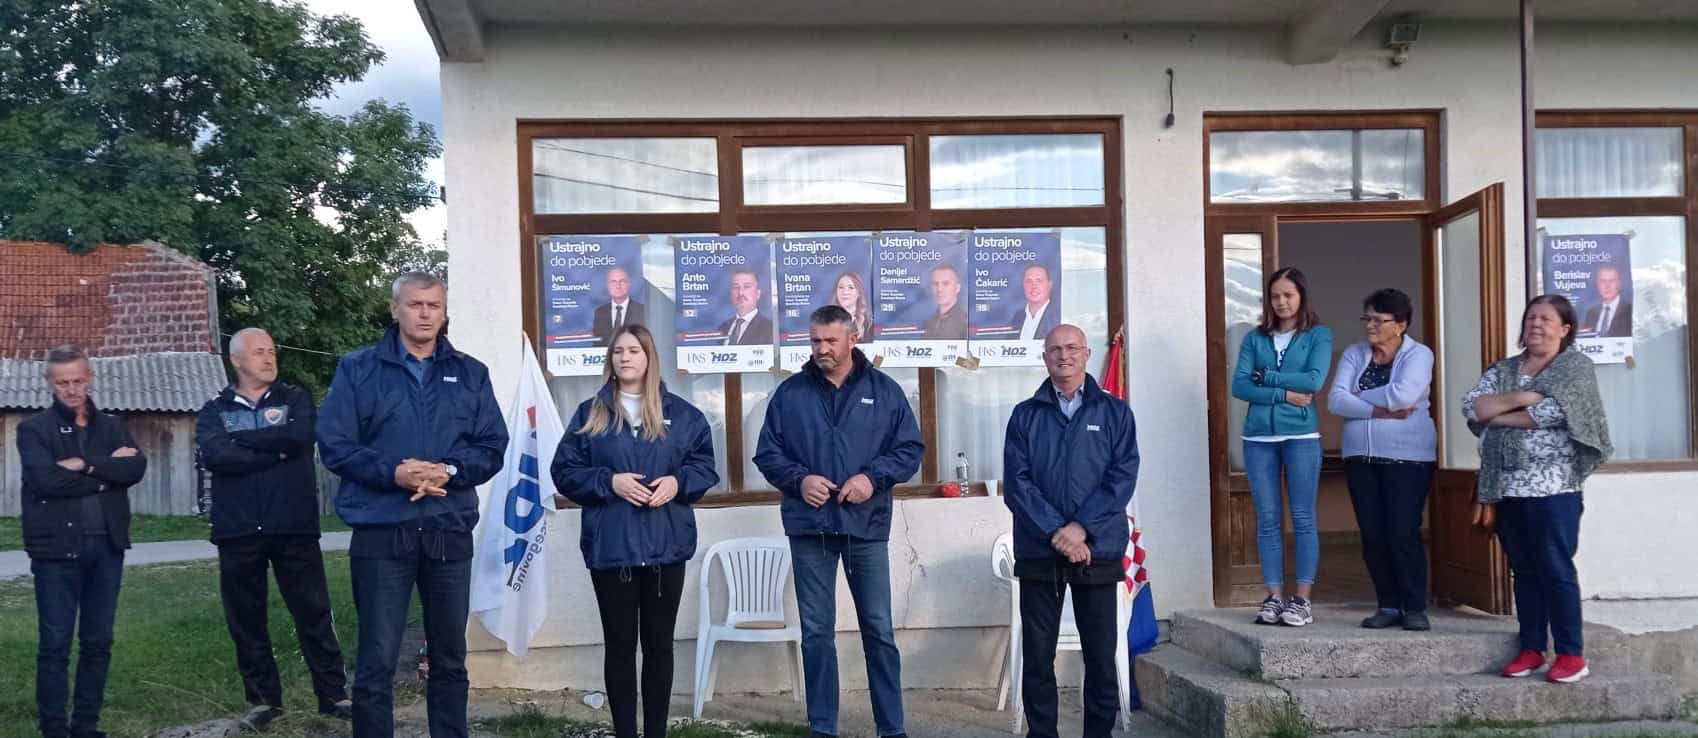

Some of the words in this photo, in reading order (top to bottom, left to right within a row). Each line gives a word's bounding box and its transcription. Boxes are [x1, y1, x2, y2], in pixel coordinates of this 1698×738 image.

[550, 241, 600, 255] Ustrajno
[681, 240, 730, 254] Ustrajno
[783, 240, 831, 254] Ustrajno
[880, 236, 927, 249] Ustrajno
[975, 236, 1022, 249] Ustrajno
[1551, 239, 1597, 251] Ustrajno
[551, 256, 566, 266] do
[568, 255, 616, 268] pobjede
[681, 255, 696, 265] do
[699, 254, 745, 268] pobjede
[783, 255, 799, 266] do
[801, 253, 846, 267] pobjede
[880, 250, 894, 261] do
[897, 249, 941, 263] pobjede
[975, 250, 989, 261] do
[992, 250, 1036, 263] pobjede
[1552, 253, 1567, 263] do
[1570, 251, 1611, 264] pobjede
[682, 272, 706, 282] Anto
[880, 267, 908, 277] Danijel
[976, 267, 989, 276] Ivo
[1554, 270, 1591, 280] Berislav
[551, 274, 565, 282] Ivo
[784, 273, 811, 282] Ivana
[976, 277, 1008, 287] Čakarić
[682, 282, 709, 291] Brtan
[785, 283, 811, 292] Brtan
[1554, 280, 1586, 291] Vujeva
[906, 346, 932, 357] HDZ
[1001, 346, 1027, 356] HDZ
[711, 352, 737, 362] HDZ
